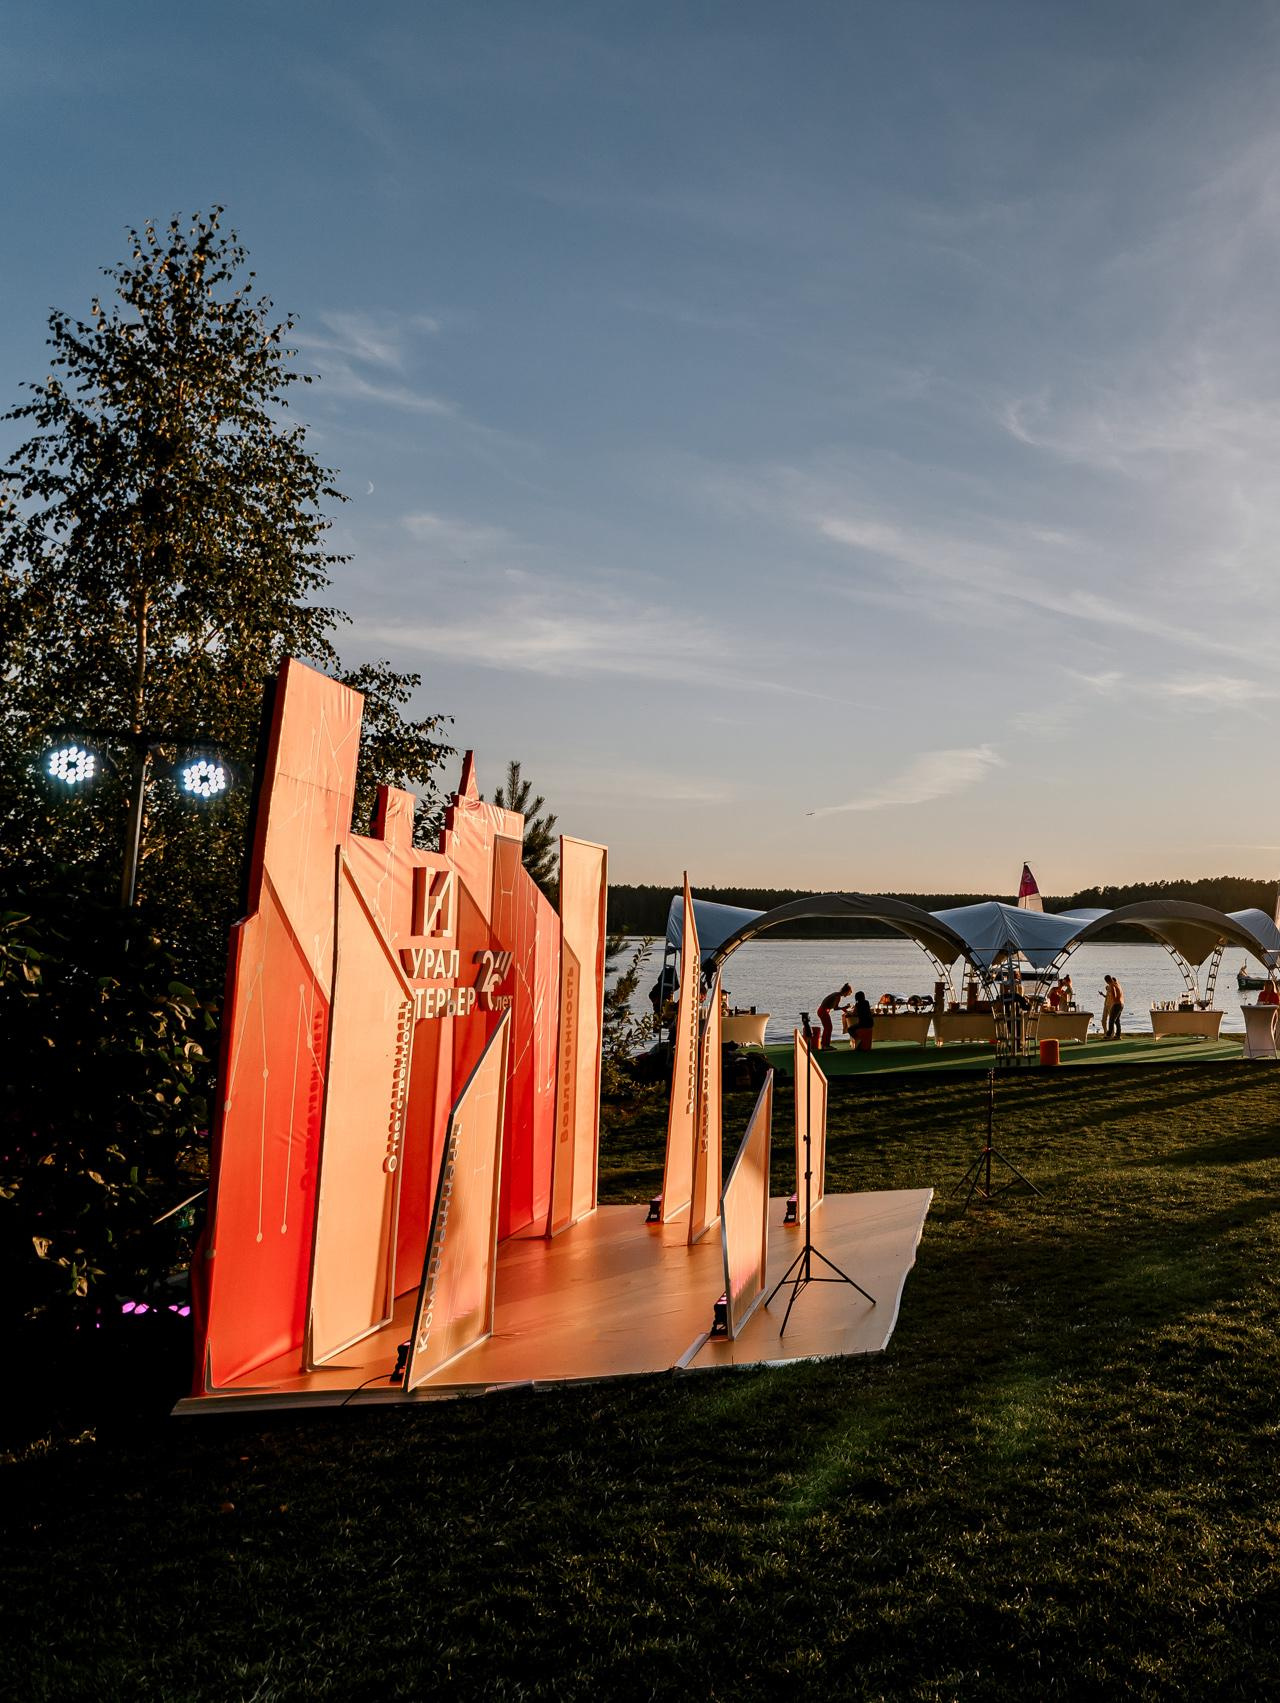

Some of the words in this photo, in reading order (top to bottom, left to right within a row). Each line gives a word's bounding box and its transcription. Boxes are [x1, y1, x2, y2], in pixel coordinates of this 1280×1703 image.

[411, 948, 460, 979] УРАЛ
[415, 987, 476, 1019] ТЕРЬЕР
[386, 1000, 412, 1173] Ответственность
